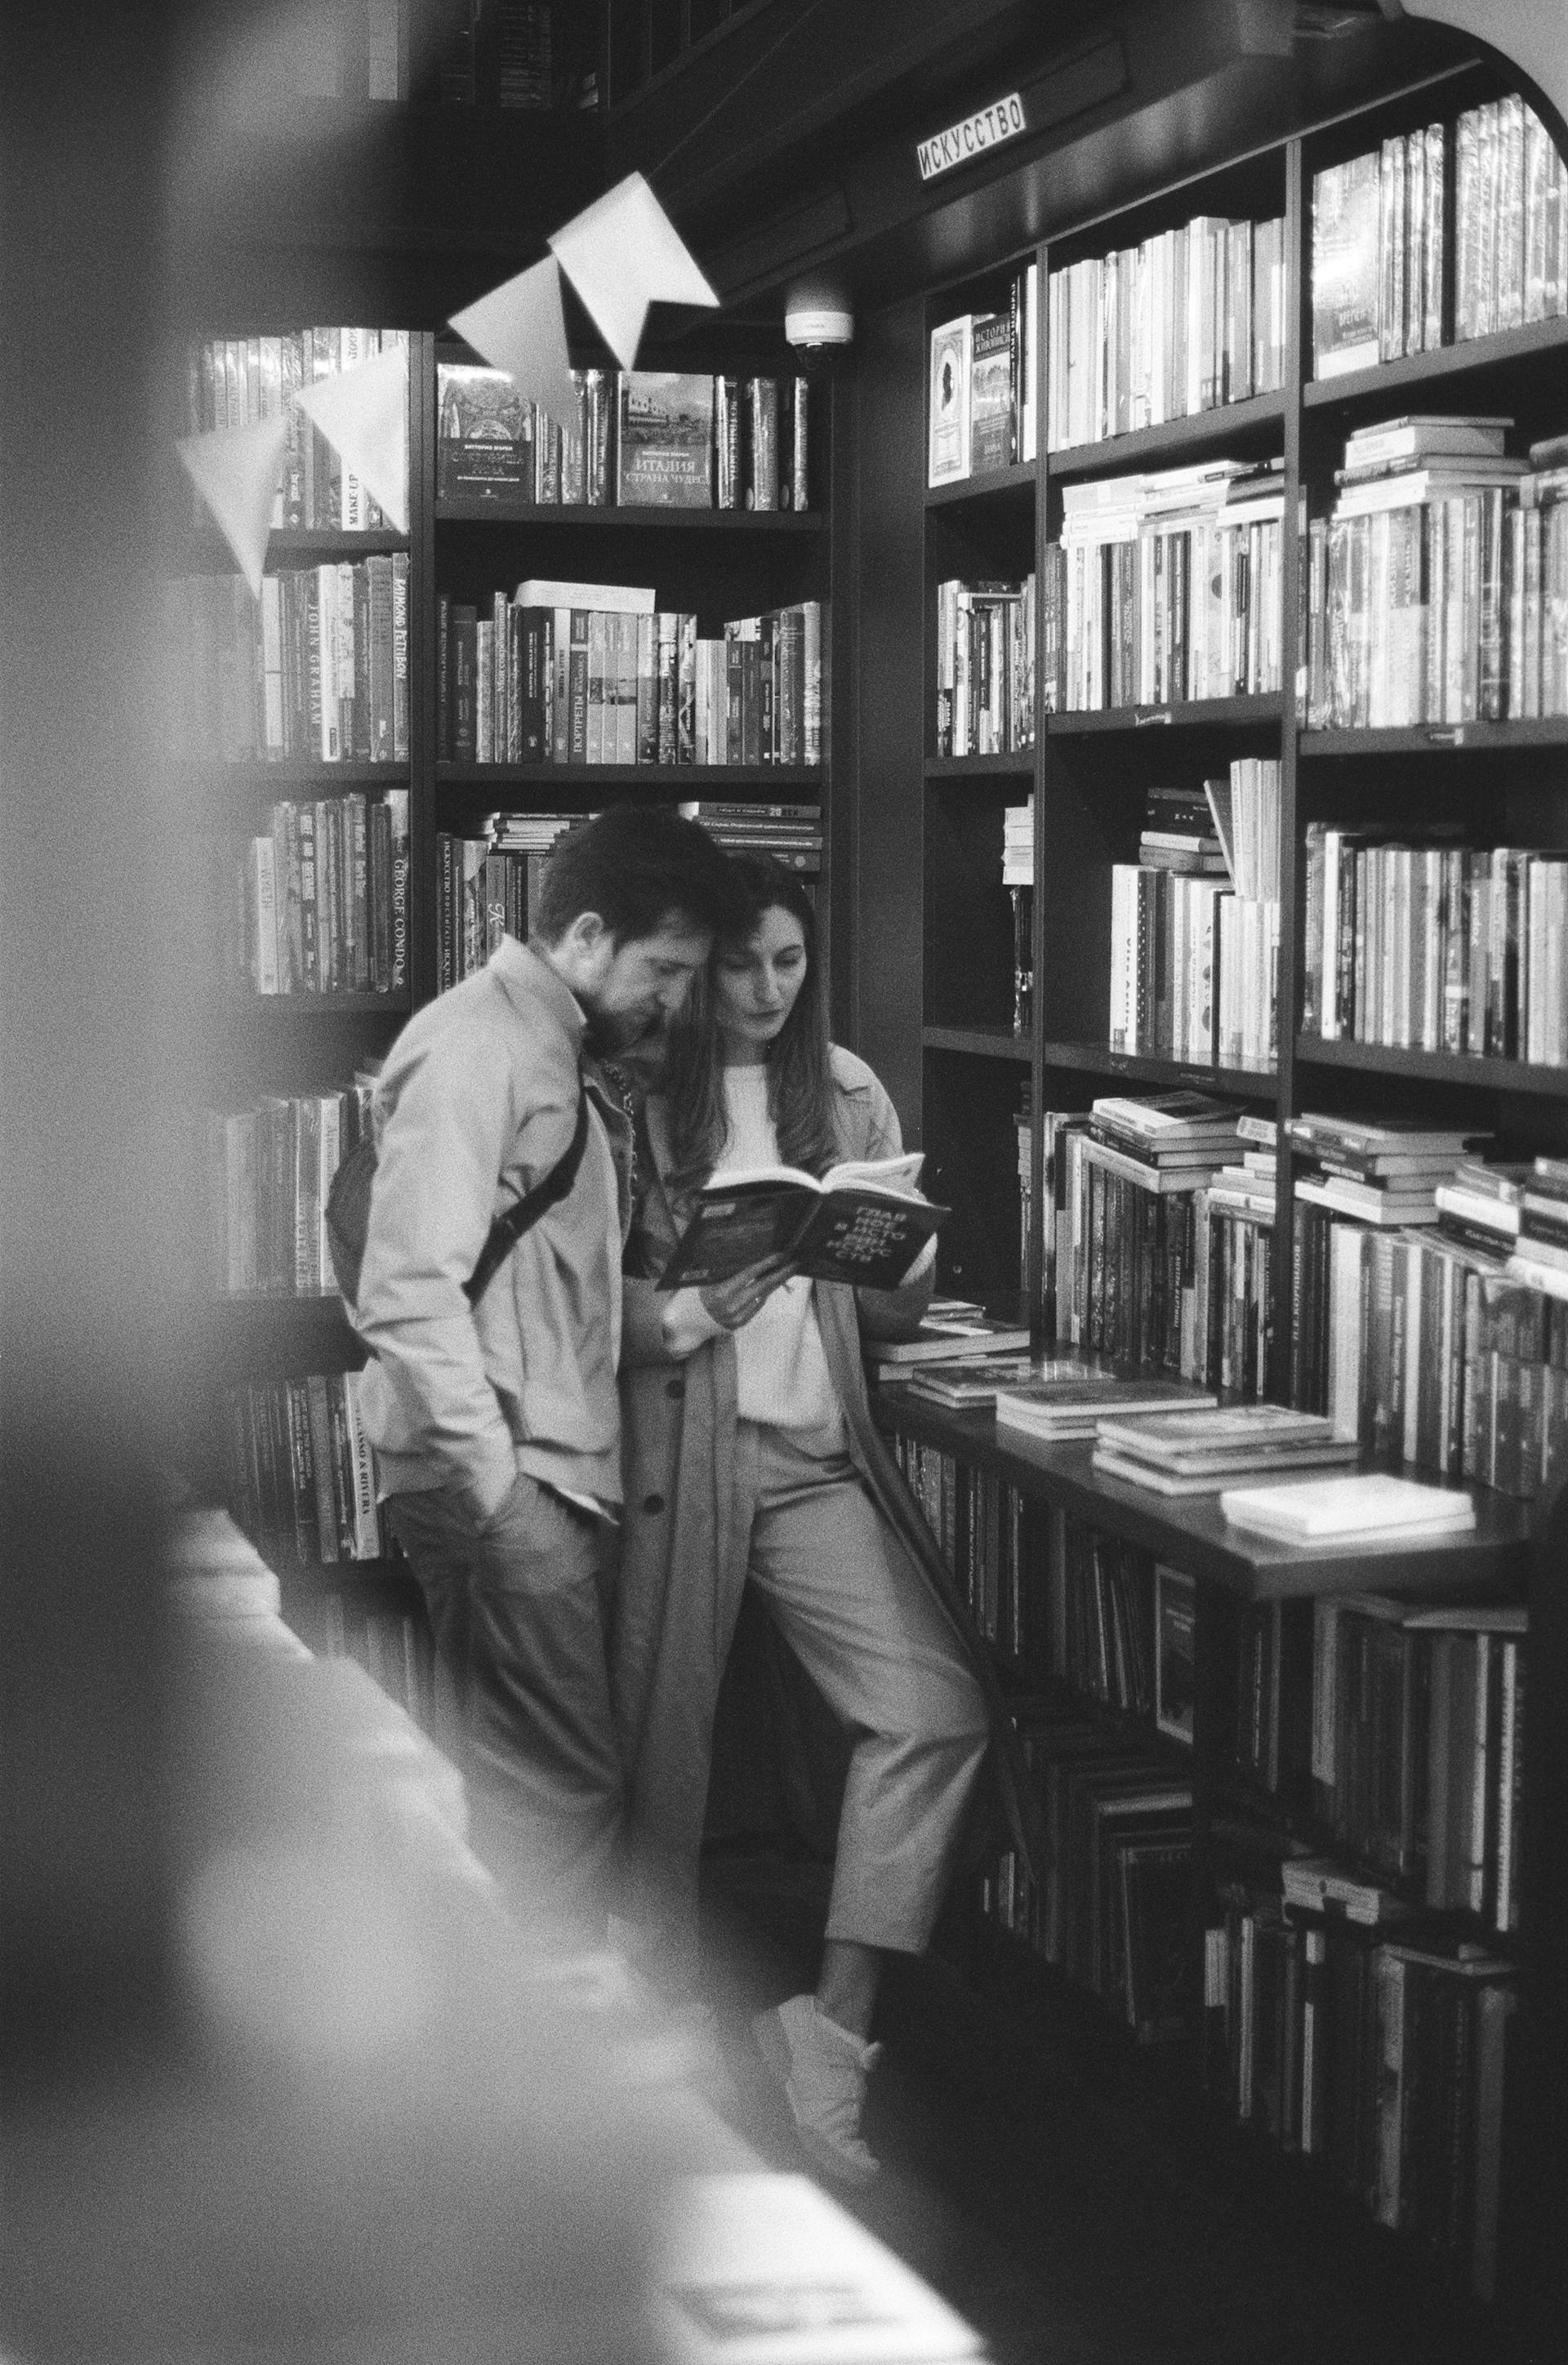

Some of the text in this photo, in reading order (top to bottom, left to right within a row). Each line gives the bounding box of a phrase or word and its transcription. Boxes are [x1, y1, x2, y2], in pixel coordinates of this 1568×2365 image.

[918, 99, 1022, 176] ИСКУССТВО
[626, 472, 706, 484] СТРАНА ЧУДЕС
[635, 458, 696, 473] ИТАЛИЯ
[394, 578, 408, 679] RAYMOND PETTIBON
[308, 603, 321, 725] JOHN GRAHAM
[572, 695, 583, 753] ПОРТРЕТЫ
[394, 858, 407, 915] GEORGE
[394, 917, 407, 969] CONDO
[359, 1471, 370, 1516] RIVERA
